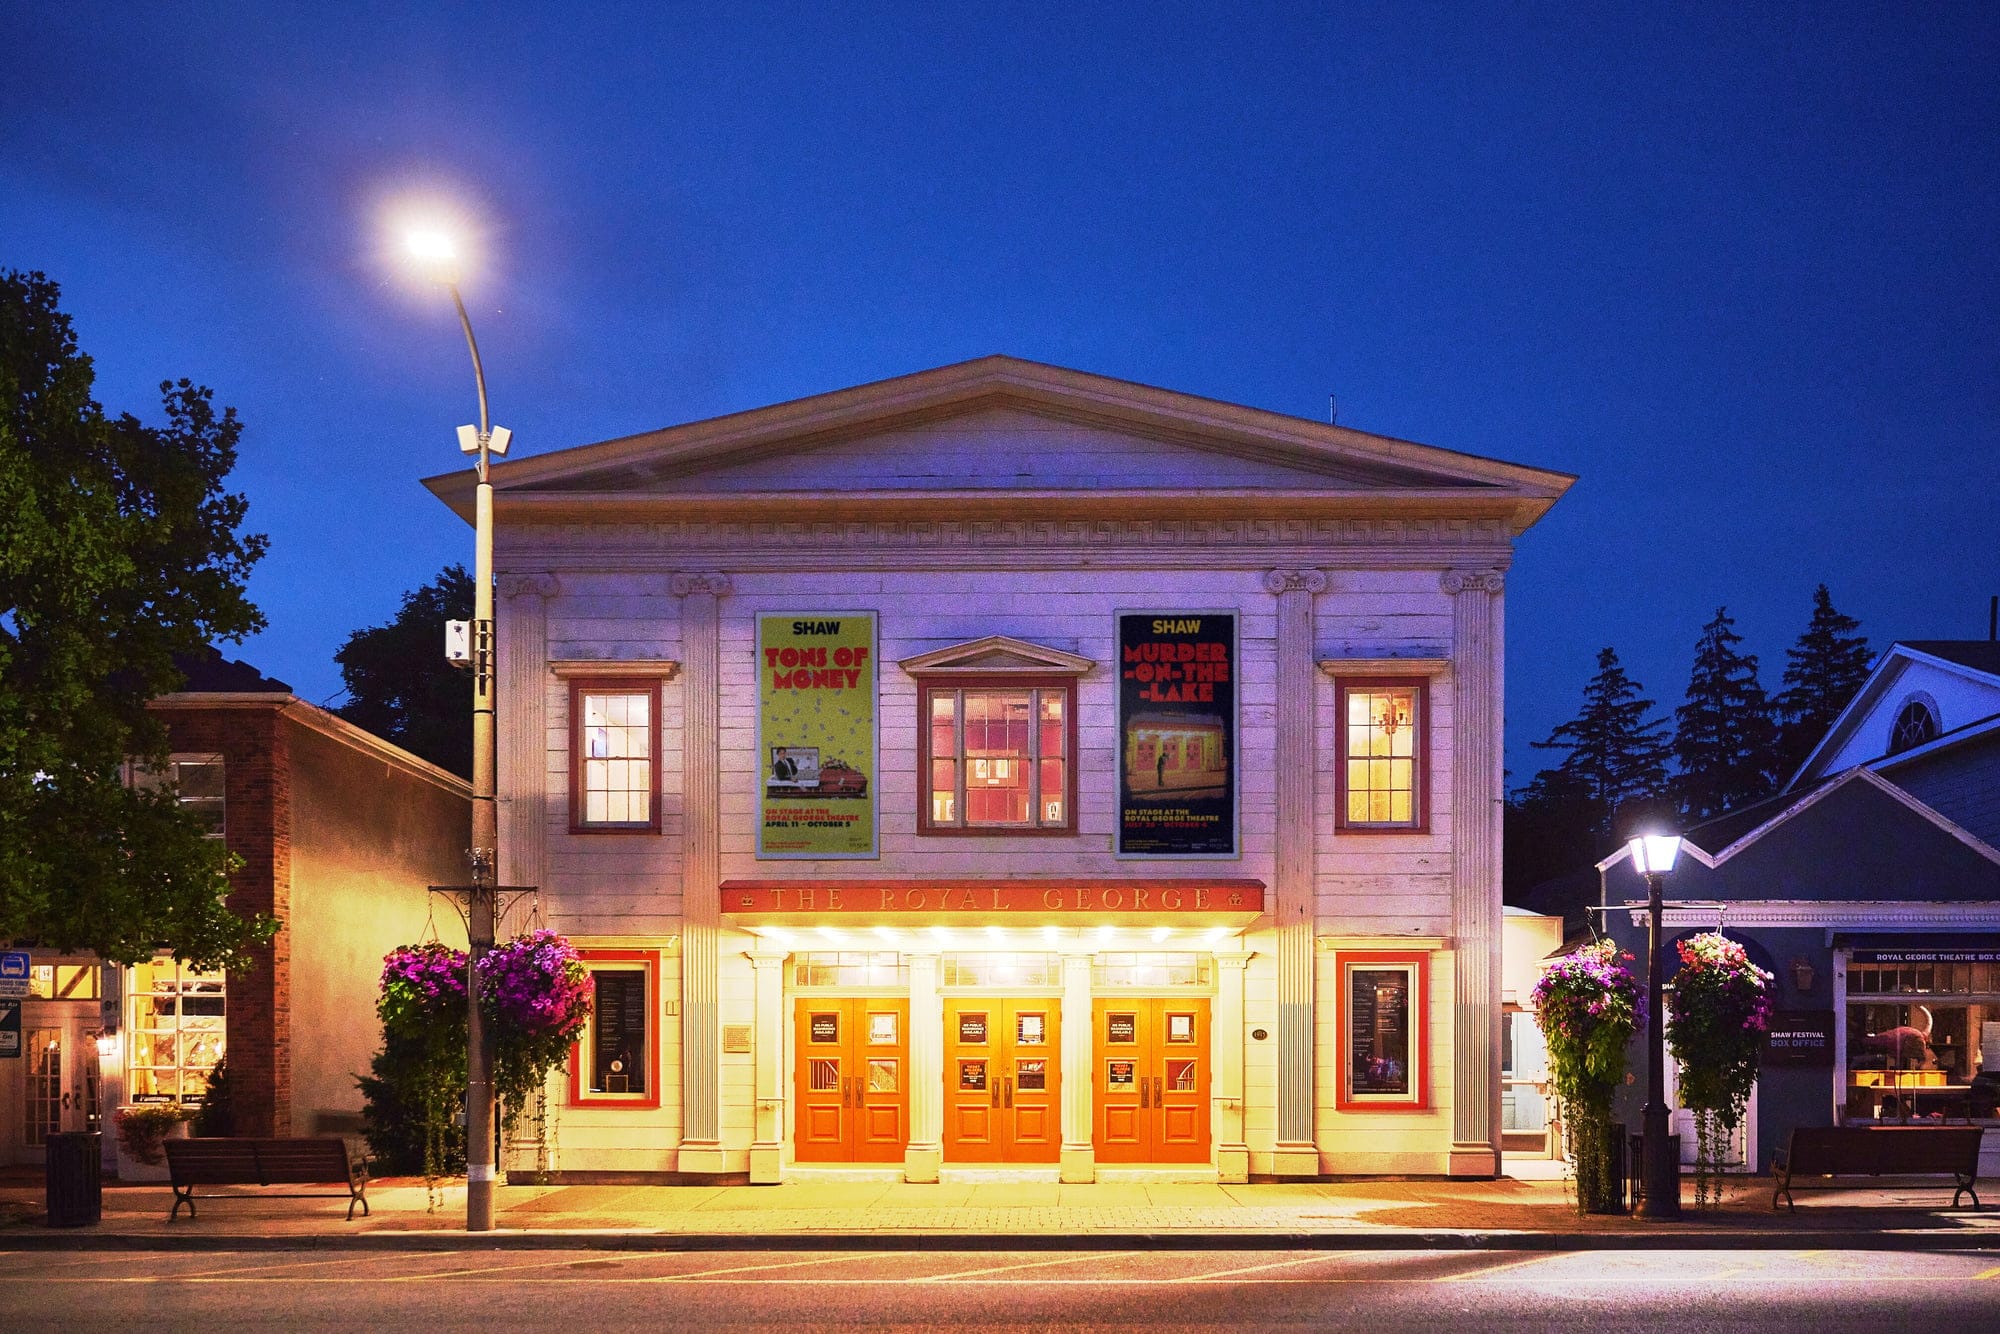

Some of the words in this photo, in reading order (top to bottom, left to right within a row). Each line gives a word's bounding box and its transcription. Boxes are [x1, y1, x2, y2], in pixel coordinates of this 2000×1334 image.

[793, 621, 840, 635] SHAW
[1152, 620, 1201, 634] SHAW
[764, 647, 827, 668] TONS
[833, 647, 868, 668] OF
[1124, 642, 1228, 662] MURDER
[773, 668, 861, 689] MONEY
[770, 888, 844, 910] THE
[879, 888, 1010, 910] ROYAL
[1043, 888, 1211, 910] GEORGE
[1770, 1039, 1789, 1047] BOX
[1792, 1039, 1825, 1047] OFFICE
